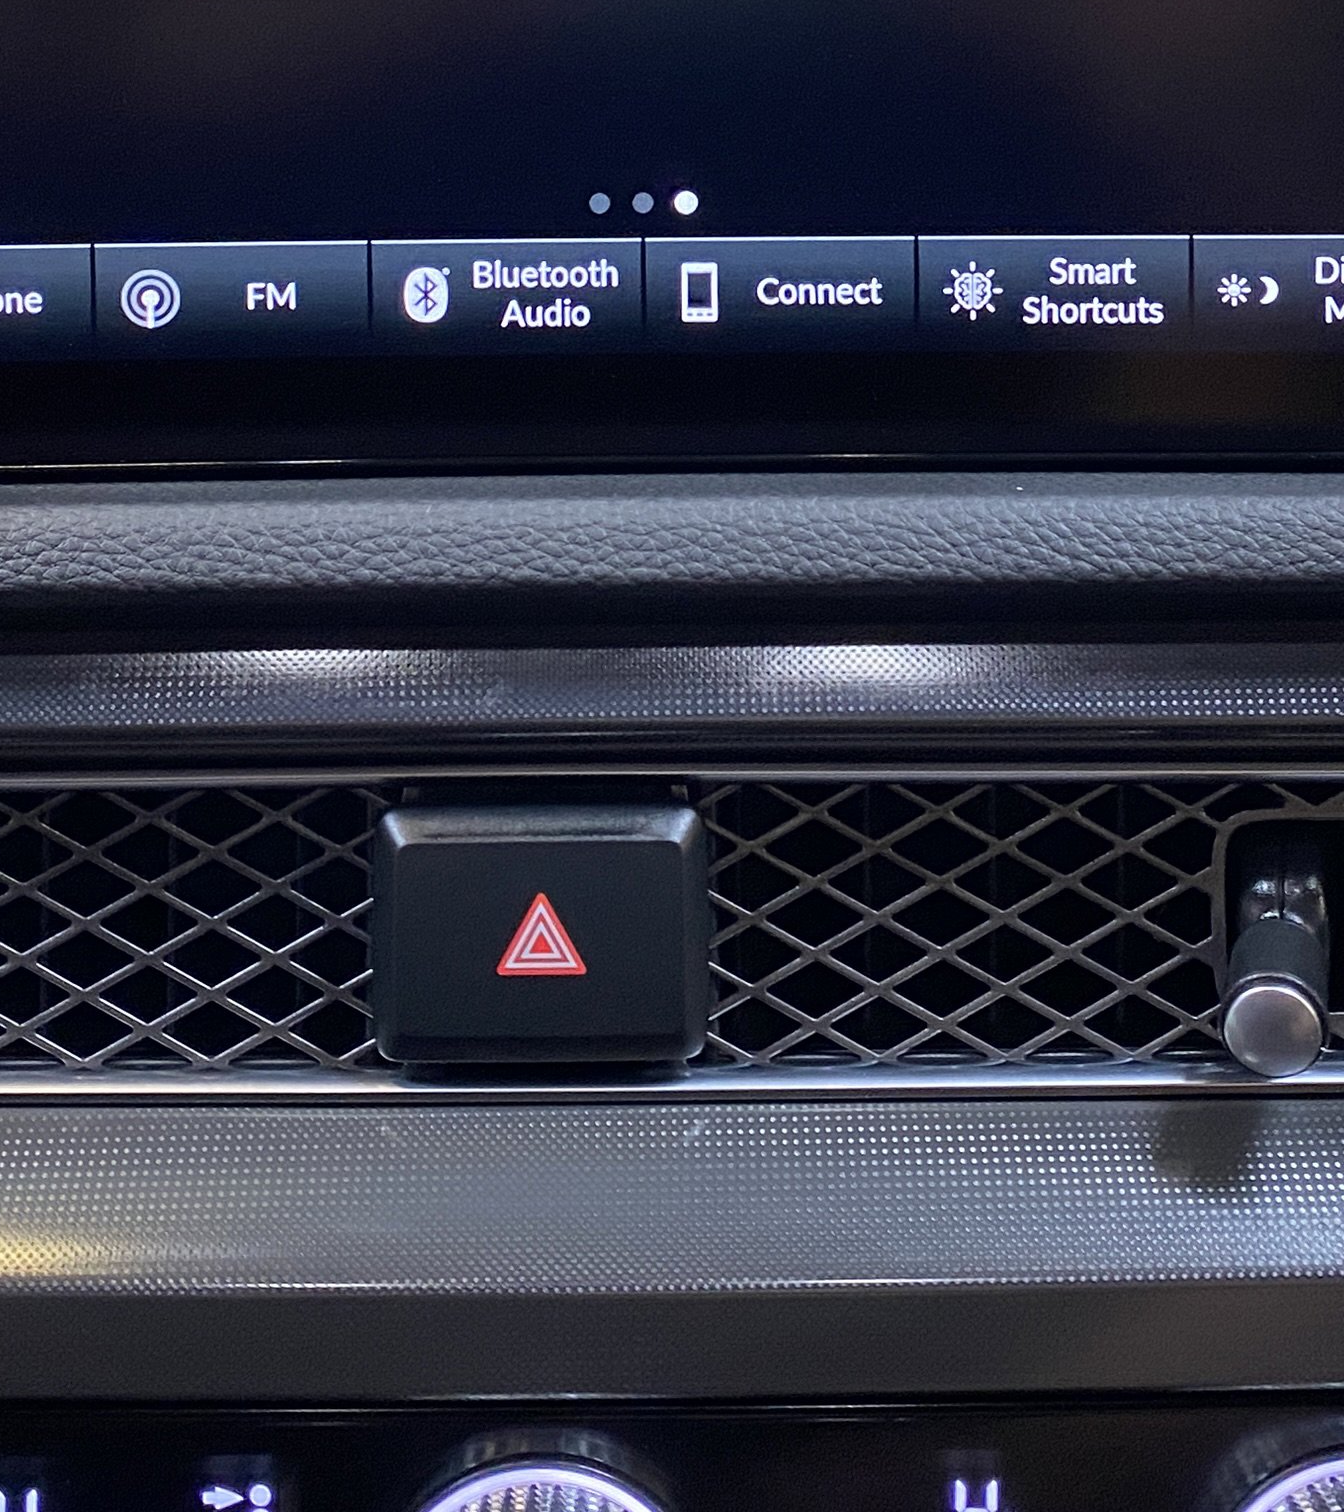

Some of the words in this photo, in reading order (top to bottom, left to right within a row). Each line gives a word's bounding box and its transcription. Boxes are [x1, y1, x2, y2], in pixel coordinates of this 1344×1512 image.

[472, 258, 619, 289] Bluetooth
[1049, 256, 1137, 286] Smart
[246, 281, 297, 311] FM
[756, 277, 884, 306] Connect
[500, 297, 591, 328] Audio
[1022, 294, 1165, 325] Shortcuts
